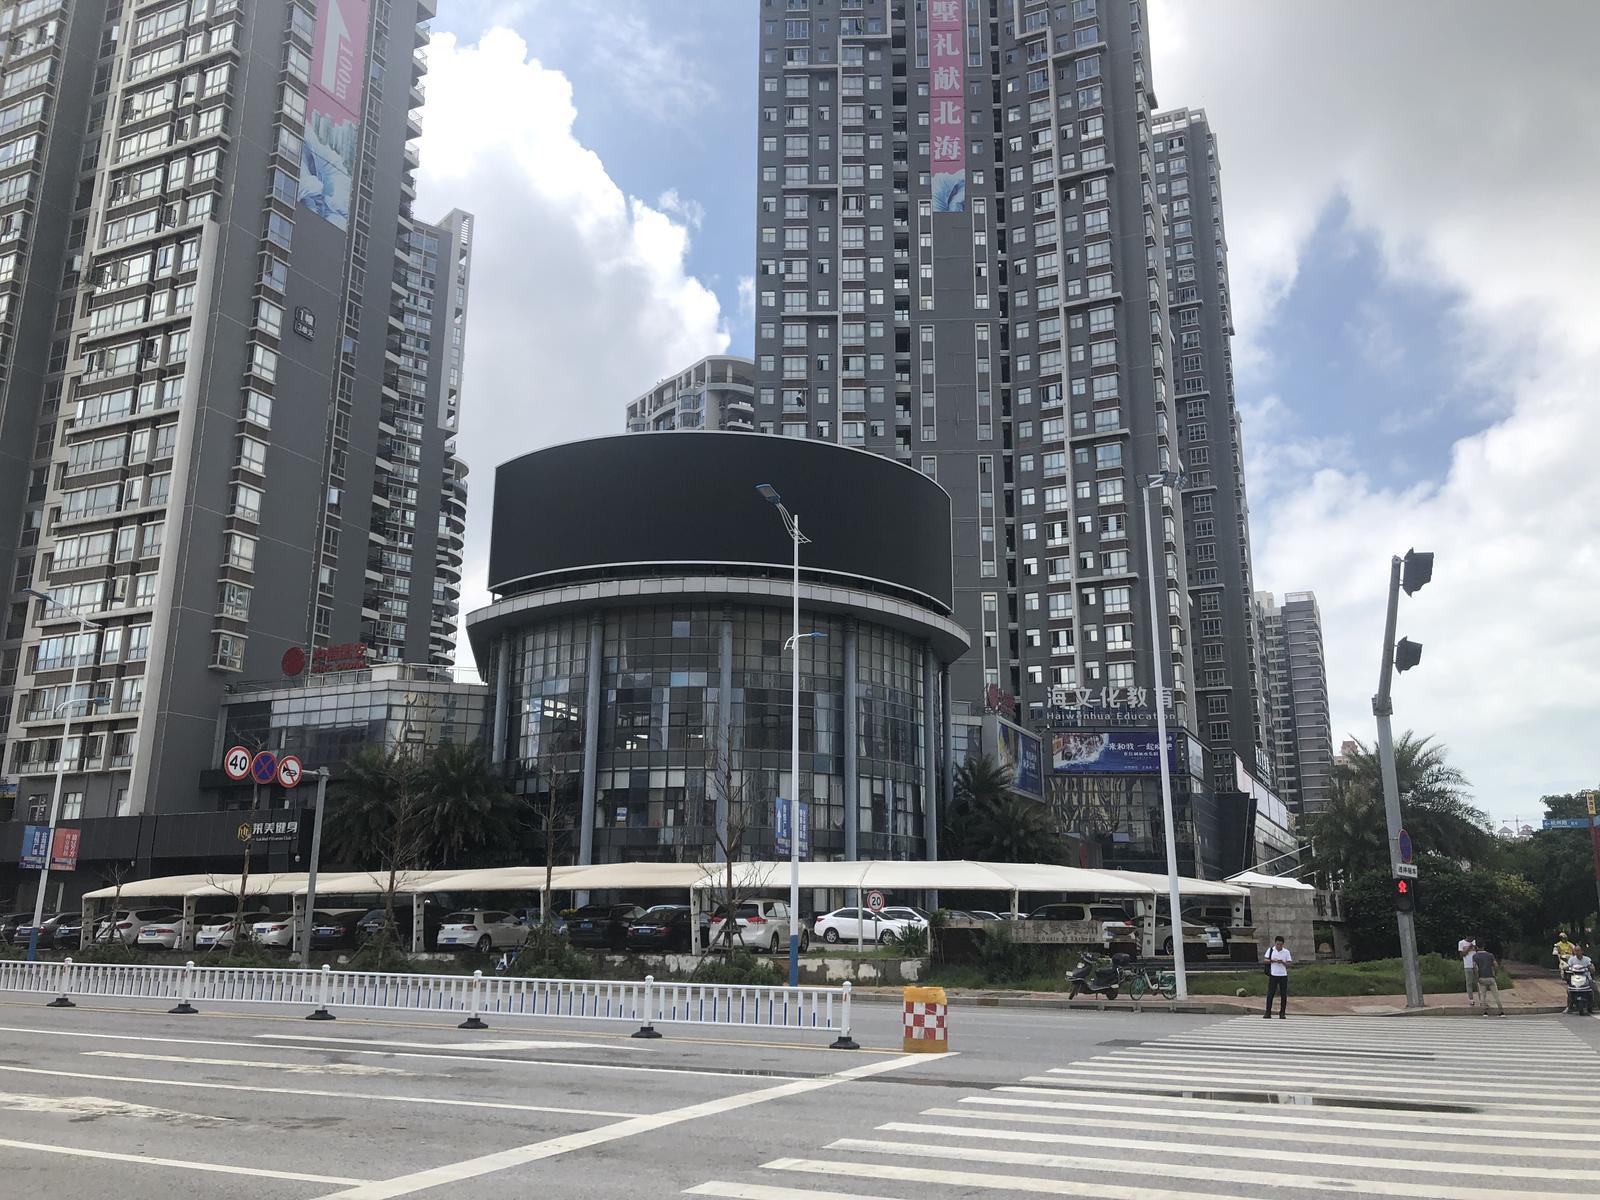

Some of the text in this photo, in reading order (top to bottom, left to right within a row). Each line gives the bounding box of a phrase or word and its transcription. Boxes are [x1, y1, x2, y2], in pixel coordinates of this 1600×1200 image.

[336, 38, 353, 100] 100m
[1046, 686, 1173, 709] 海文化教育
[1046, 712, 1176, 720] Haiwenhua Educaton
[229, 754, 248, 771] 40
[871, 896, 881, 906] 20
